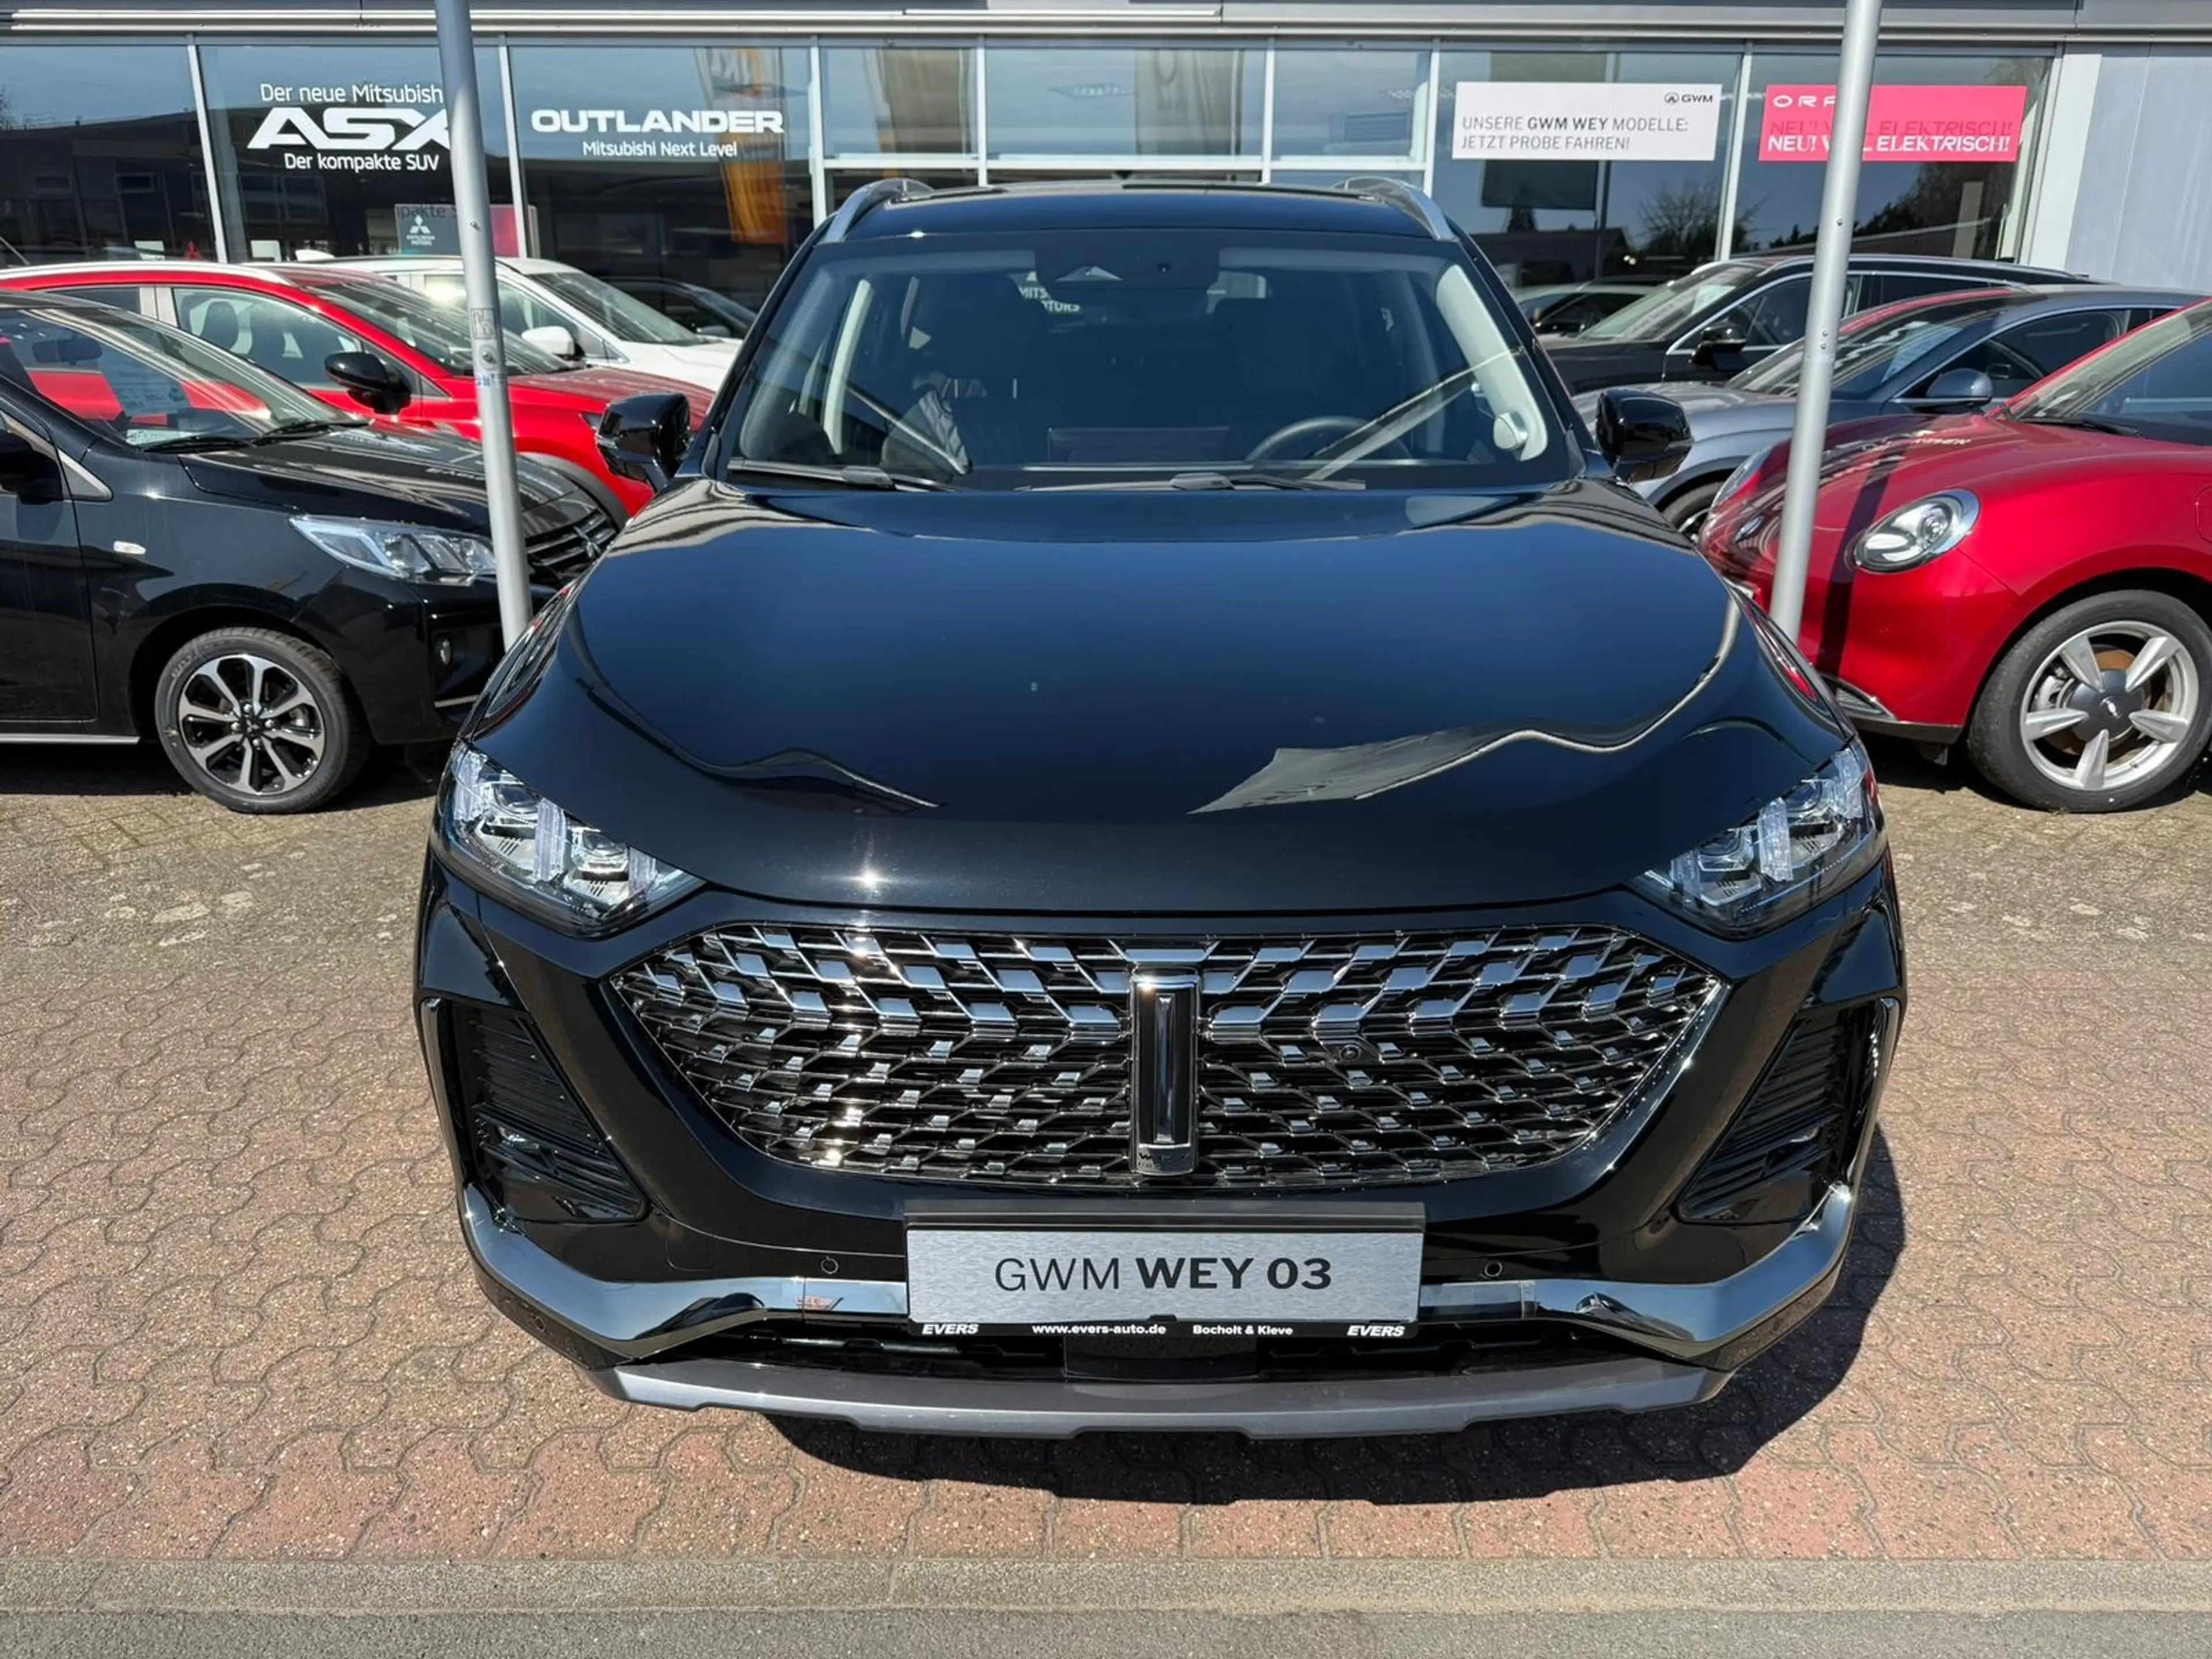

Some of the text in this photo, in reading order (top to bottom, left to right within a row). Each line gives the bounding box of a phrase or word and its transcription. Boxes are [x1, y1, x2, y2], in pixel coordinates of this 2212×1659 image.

[260, 84, 444, 104] Der neue Mitsubish
[1681, 94, 1713, 103] GWM
[247, 107, 450, 150] ASX
[531, 109, 785, 134] OUTLANDER
[1462, 116, 1688, 132] UNSERE GWM WEY MODELLE:
[582, 140, 738, 157] Mitsubishi Next Level
[1461, 135, 1630, 151] JETZT PROBE FAHREN!
[1767, 134, 1817, 153] NEU!
[1876, 135, 2011, 152] ELEKTRISCH!
[284, 153, 440, 173] Der kompakte SUV
[995, 1257, 1332, 1291] GWM WEY 03
[922, 1324, 1406, 1337] EVERS www.evers-auto.de Bocholt & Kleve EVERS
